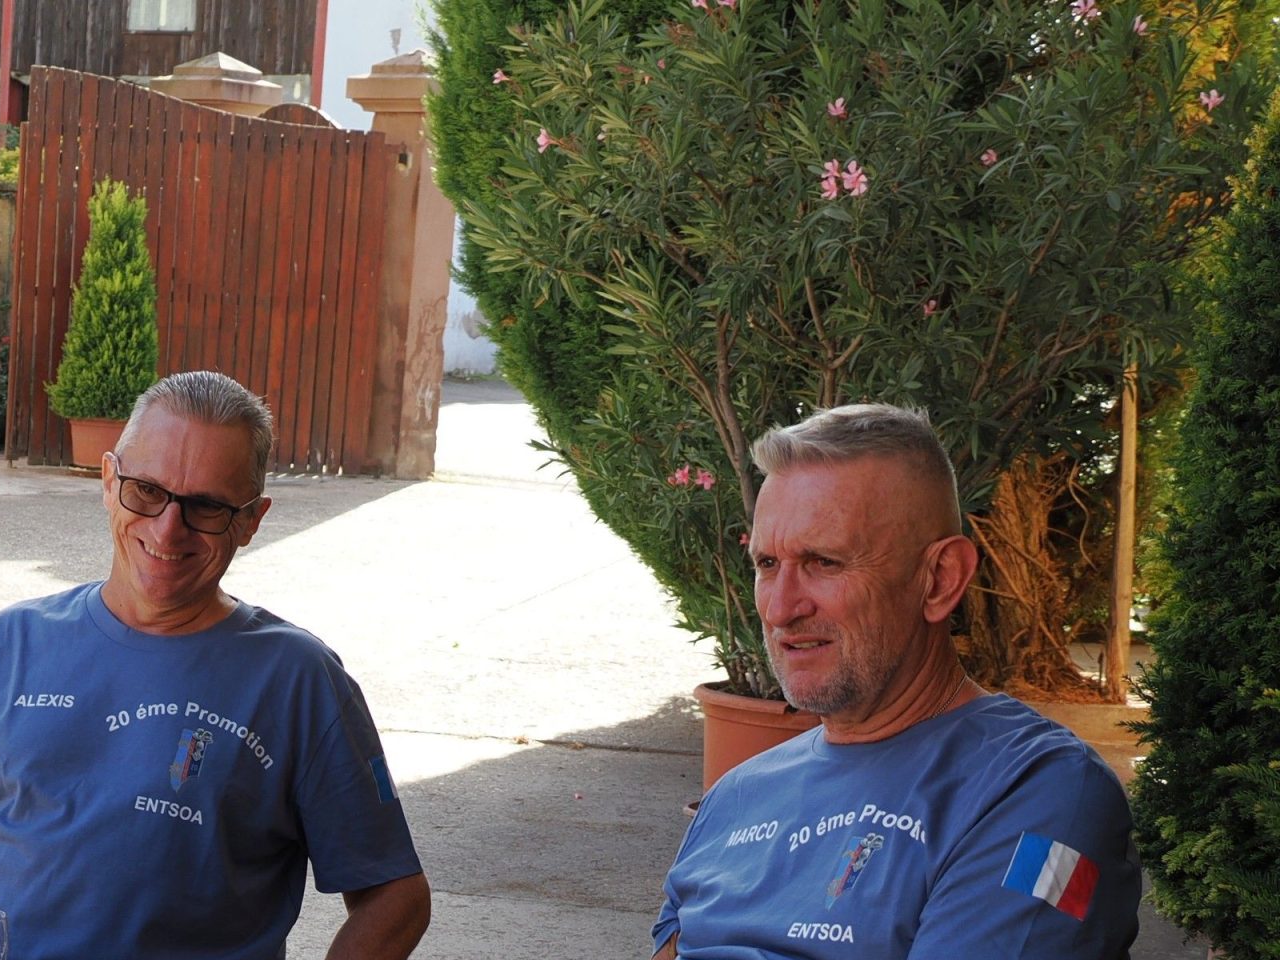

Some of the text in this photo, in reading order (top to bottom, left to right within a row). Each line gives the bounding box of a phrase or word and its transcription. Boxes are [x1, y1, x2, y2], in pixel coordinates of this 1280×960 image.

[13, 694, 75, 708] ALEXIS
[106, 701, 274, 770] 20 éme Promotion
[134, 795, 203, 825] ENTSOA
[724, 820, 778, 848] MARCO
[788, 825, 811, 852] 20
[816, 811, 856, 836] éme
[787, 922, 854, 943] ENTSOA
